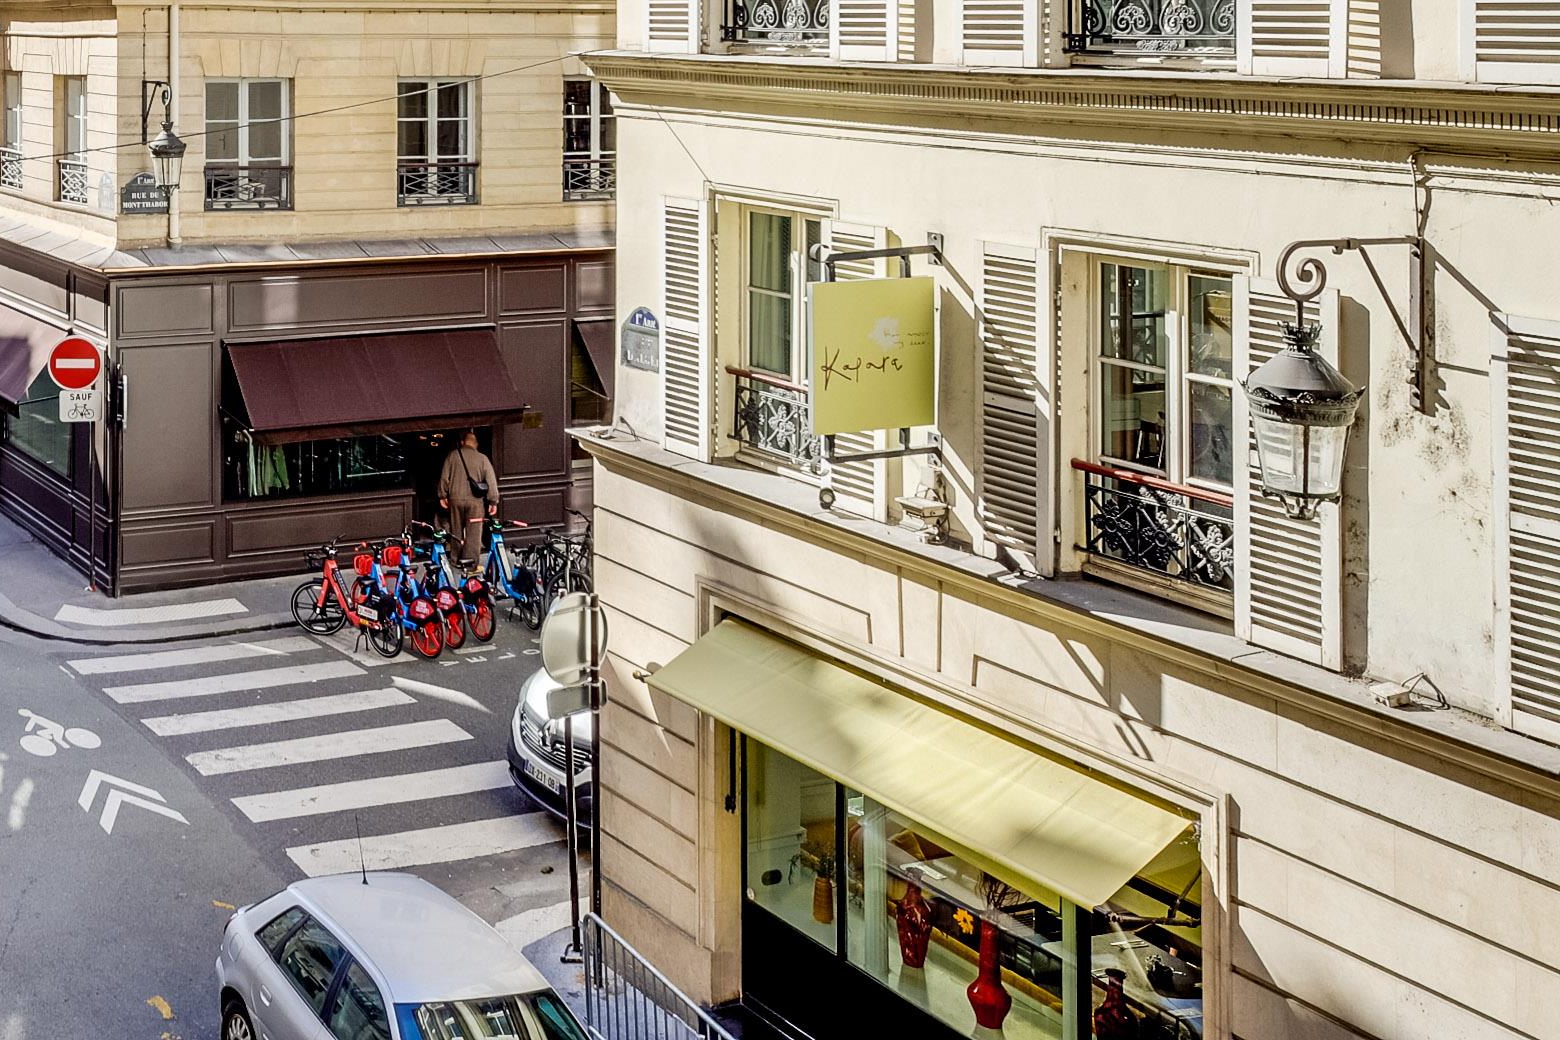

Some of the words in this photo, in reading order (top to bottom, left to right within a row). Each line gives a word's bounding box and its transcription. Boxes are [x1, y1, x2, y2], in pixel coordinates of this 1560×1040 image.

[149, 191, 160, 199] DU
[122, 201, 141, 209] MONT
[820, 346, 904, 391] Kapara
[70, 392, 93, 401] SAUF
